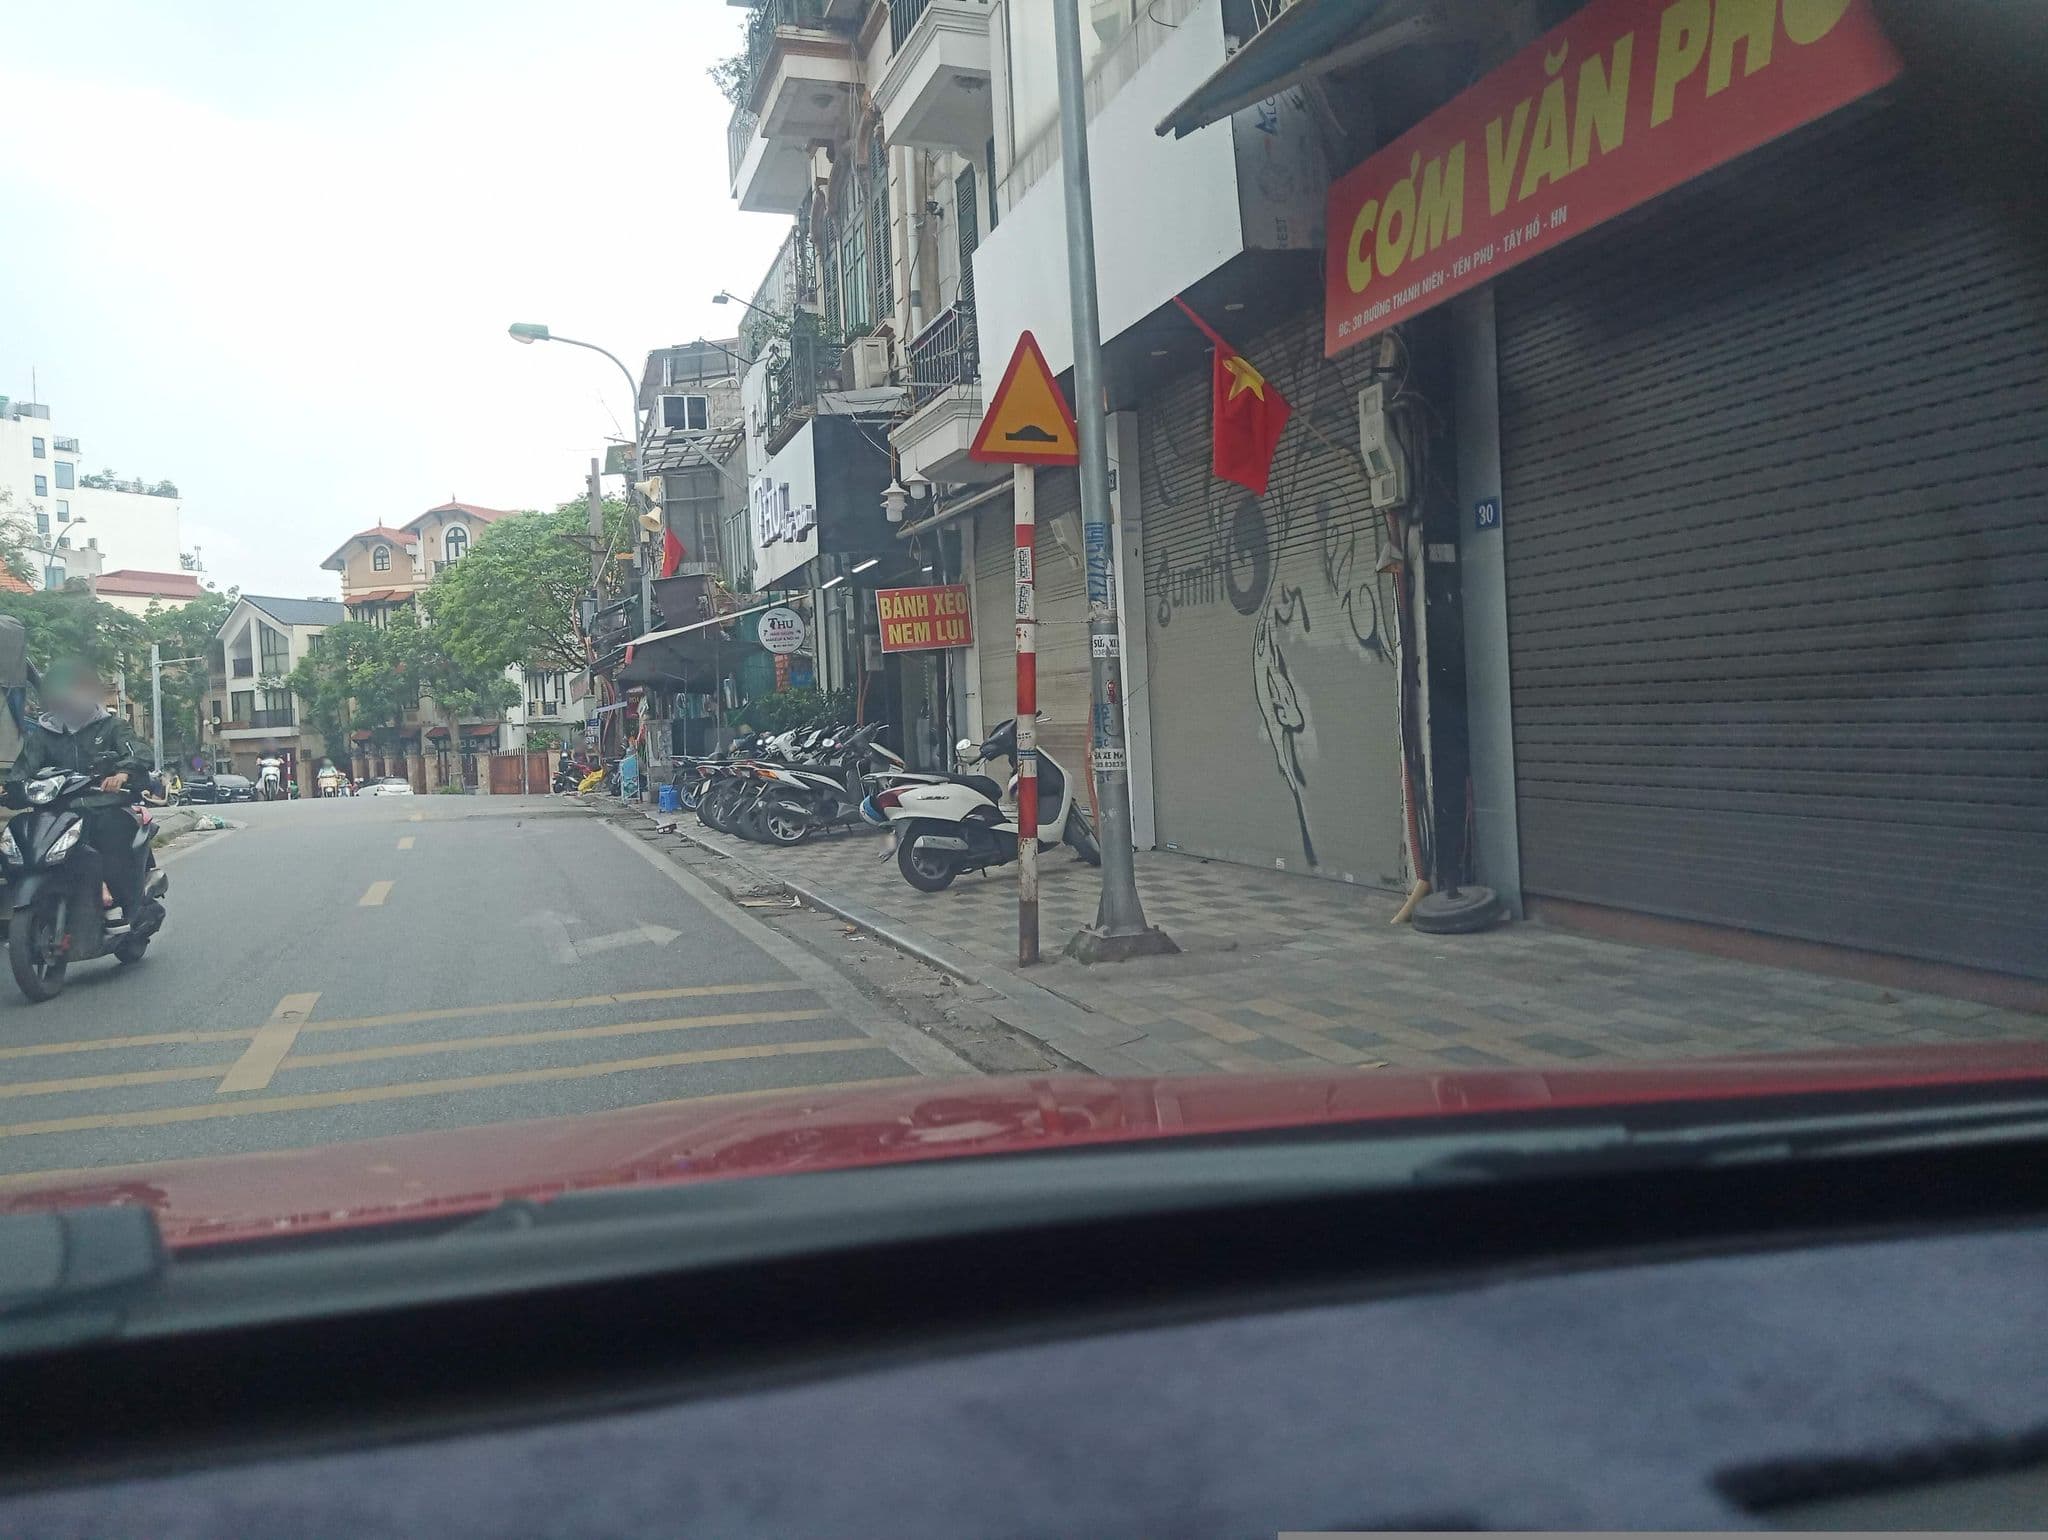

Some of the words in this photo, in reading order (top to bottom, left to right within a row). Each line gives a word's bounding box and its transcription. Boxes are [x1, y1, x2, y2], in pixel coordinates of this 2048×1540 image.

[1346, 139, 1465, 294] CƠM
[1485, 32, 1634, 217] VĂN
[1392, 282, 1420, 310] THANH
[1422, 271, 1444, 295] NIÊN
[1452, 254, 1471, 278] YÊN
[1473, 243, 1494, 267] PHỤ
[1503, 227, 1523, 253] TÂY
[1550, 205, 1568, 229] HN
[1478, 503, 1494, 525] 30
[879, 591, 929, 620] BÁNH
[933, 588, 968, 615] XÈO
[768, 617, 793, 630] THU
[888, 621, 931, 645] NEM
[936, 618, 965, 645] LỤI
